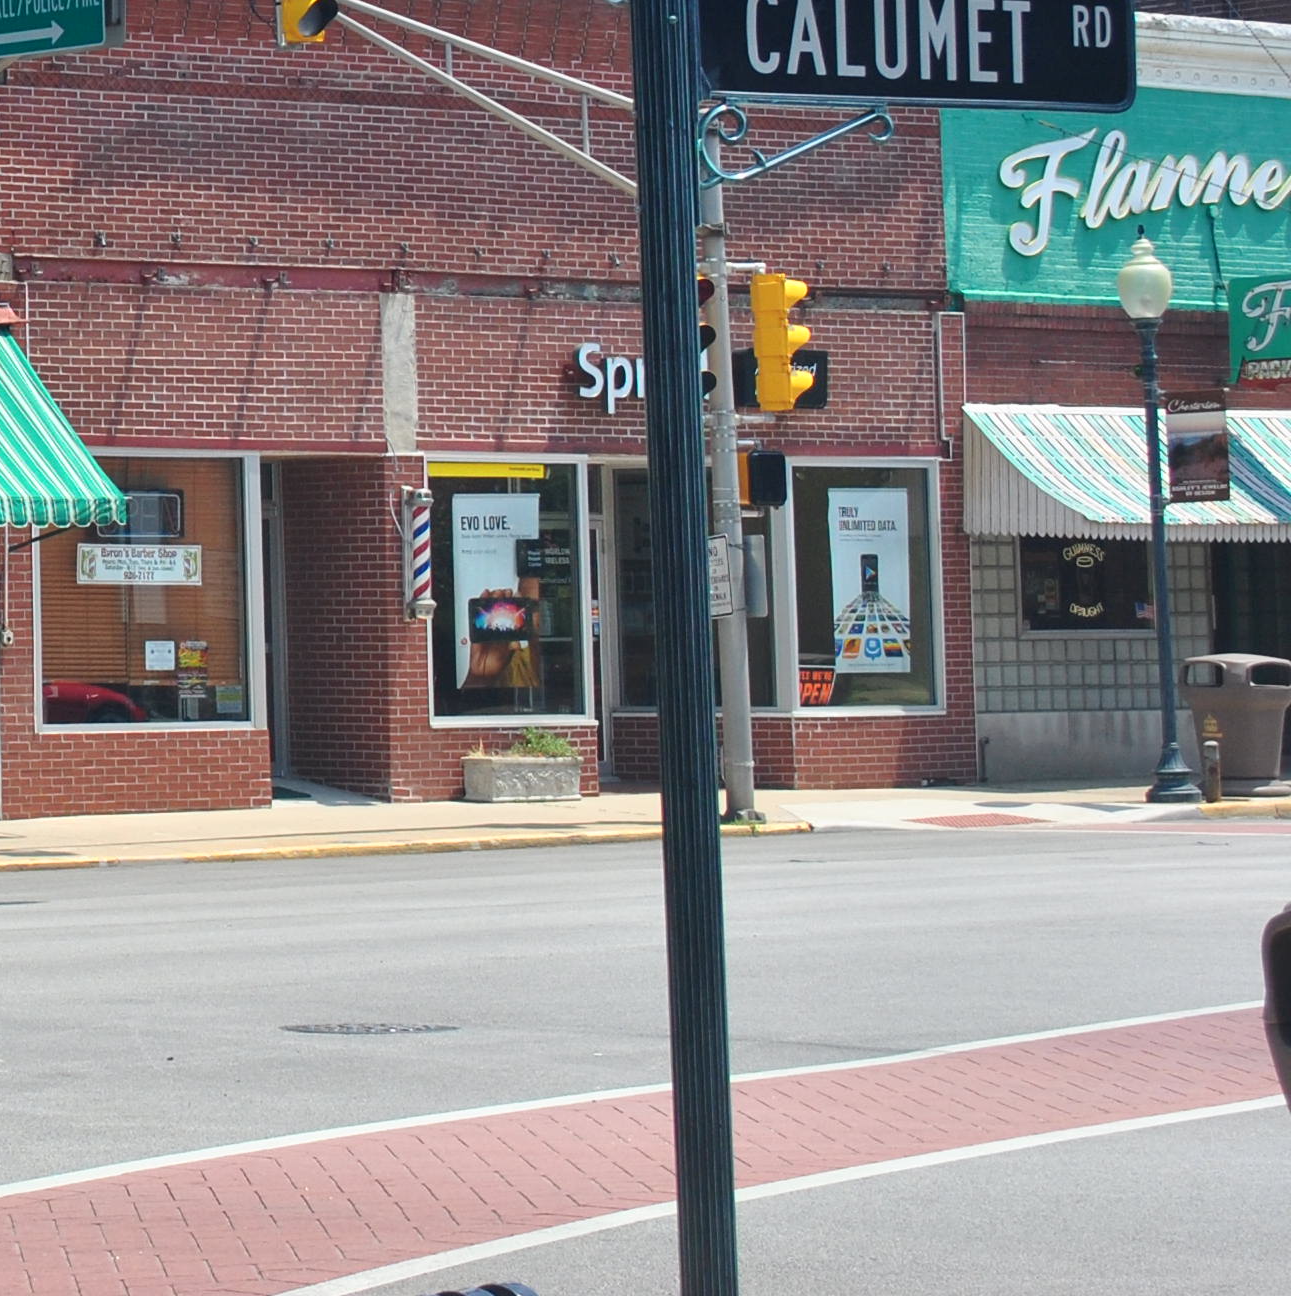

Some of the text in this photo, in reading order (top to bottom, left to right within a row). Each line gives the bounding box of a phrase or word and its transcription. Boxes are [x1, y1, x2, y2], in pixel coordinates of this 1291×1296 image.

[1072, 5, 1111, 49] RD
[838, 506, 859, 518] TRULY
[461, 515, 511, 531] EVO LOVE.
[839, 520, 875, 531] UNLIMITED
[1062, 543, 1105, 562] GUINNESS
[800, 682, 832, 705] PEN
